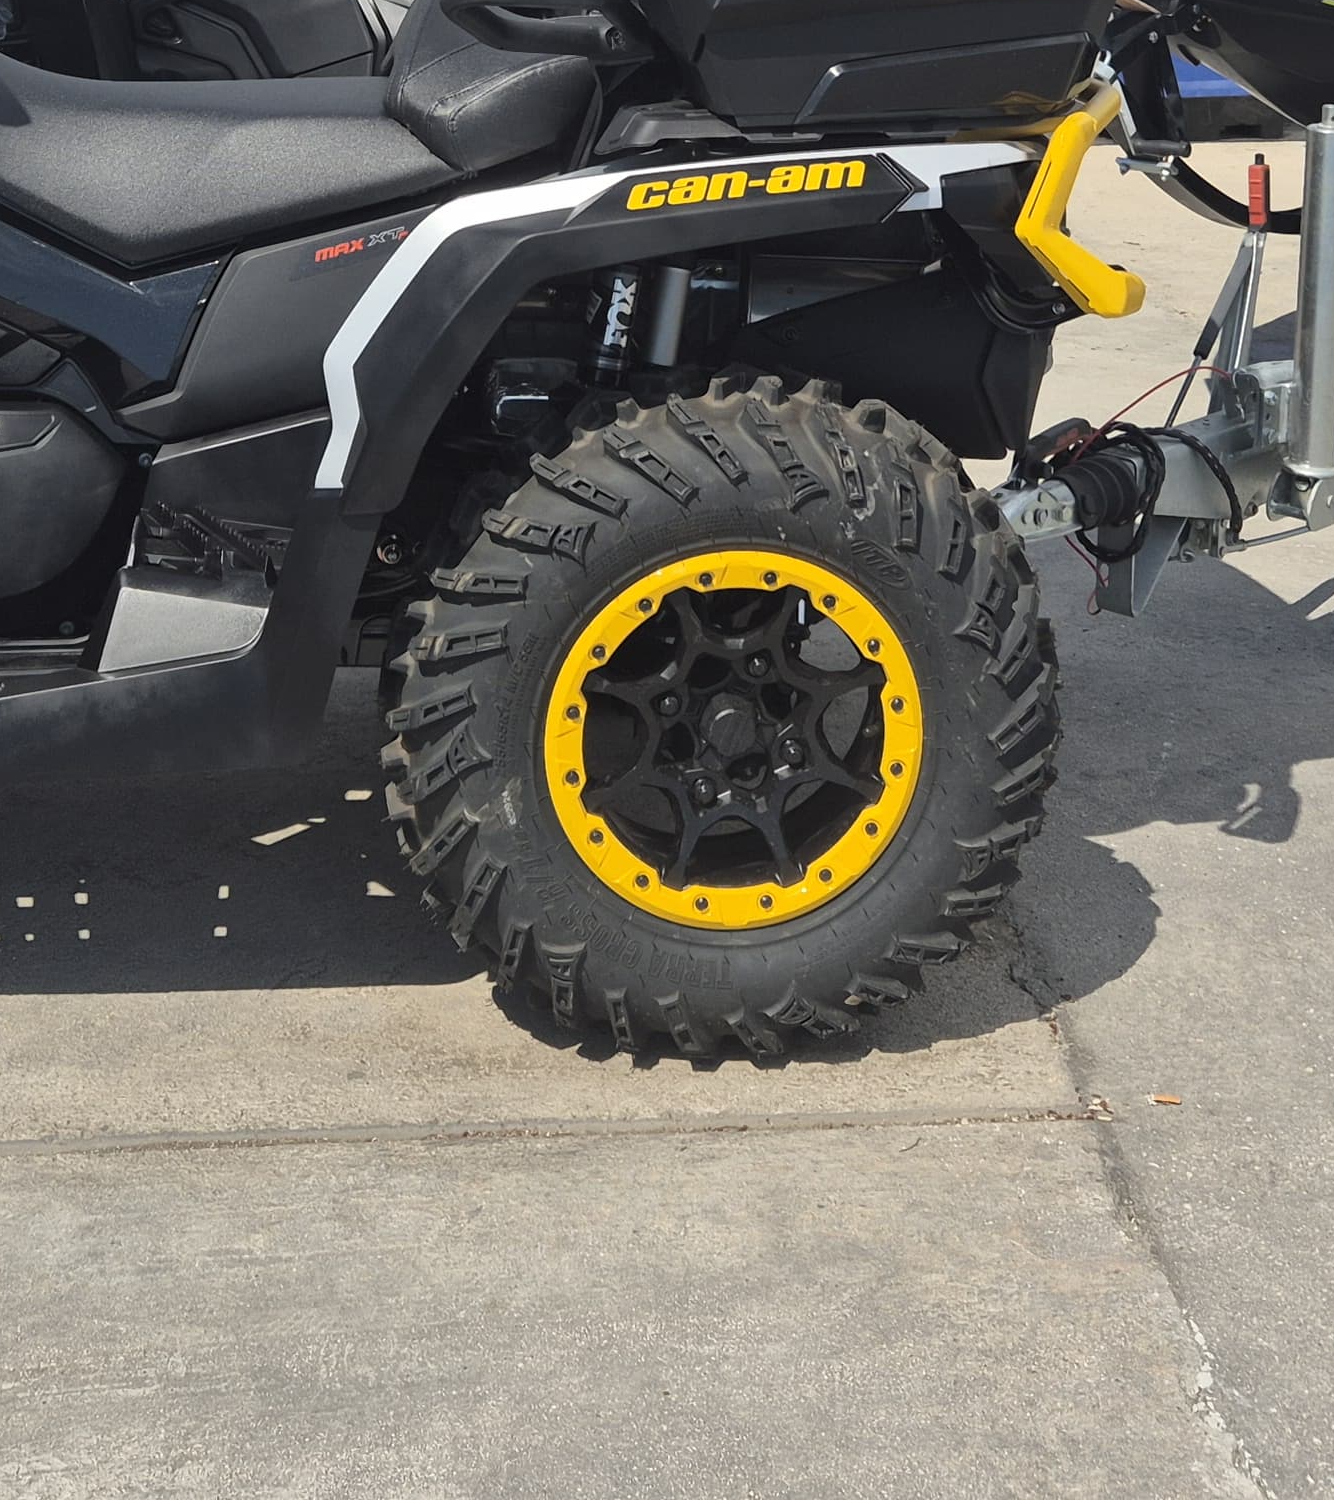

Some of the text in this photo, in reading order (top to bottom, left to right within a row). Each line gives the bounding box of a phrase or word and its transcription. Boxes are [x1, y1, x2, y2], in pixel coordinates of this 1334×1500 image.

[626, 159, 866, 211] can-am
[314, 237, 365, 263] MAX
[603, 278, 637, 348] FOX
[560, 900, 644, 969] CROSS
